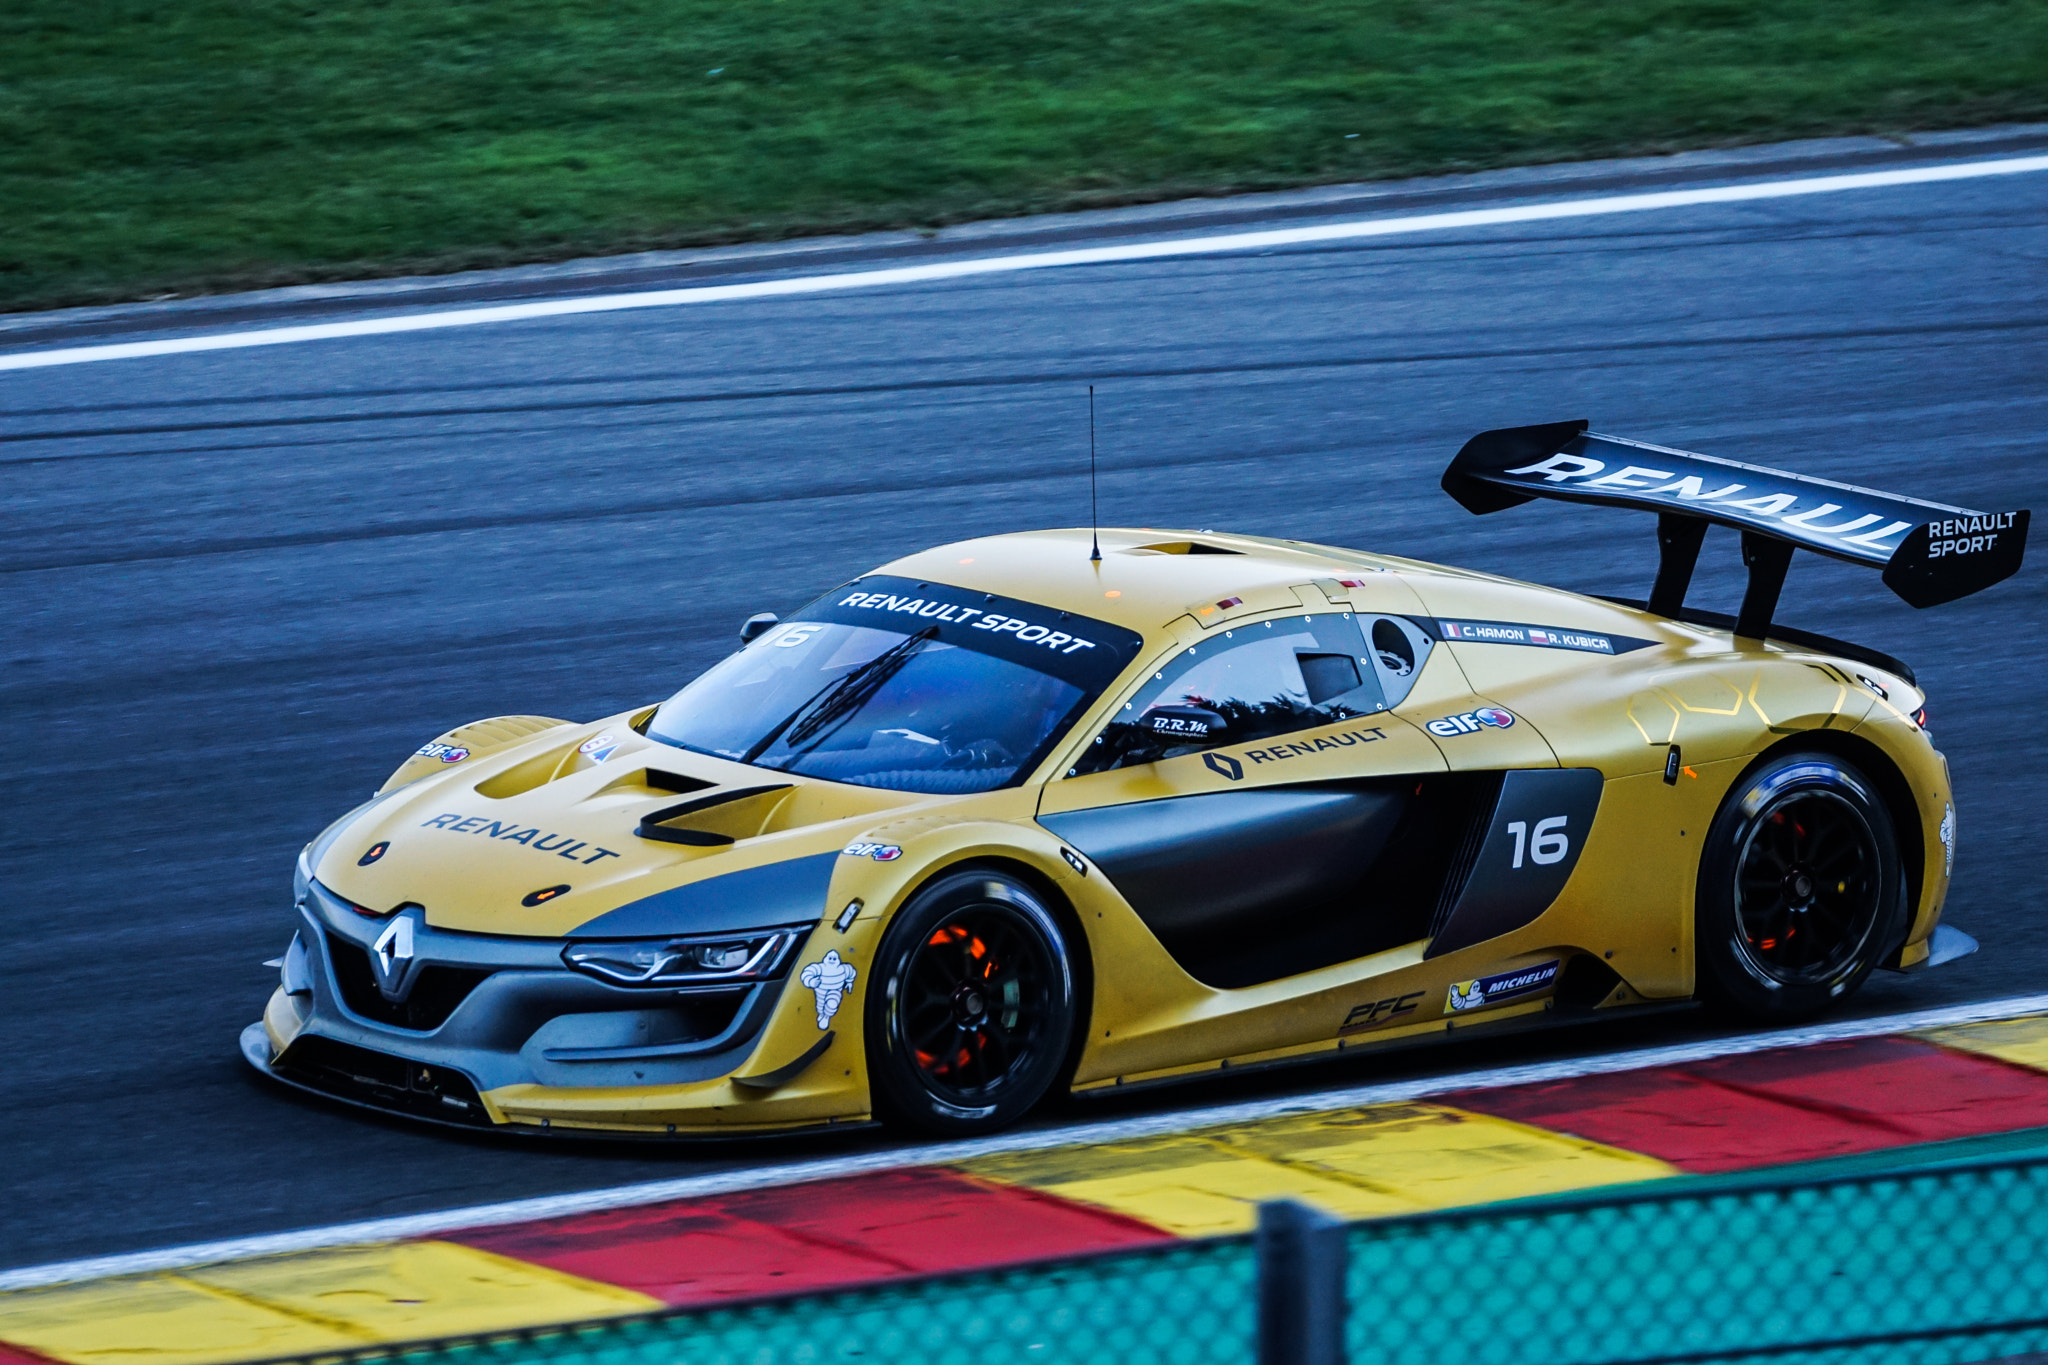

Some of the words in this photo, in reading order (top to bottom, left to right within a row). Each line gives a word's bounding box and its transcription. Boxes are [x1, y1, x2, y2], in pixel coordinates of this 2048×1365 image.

[1504, 453, 1912, 550] RENAUL
[1928, 511, 2018, 539] RENAULT
[1928, 534, 1998, 559] SPORT
[760, 624, 824, 649] 16
[838, 592, 983, 624] RENAULT
[972, 613, 1096, 654] SPORT
[1477, 627, 1525, 641] HAMON
[1548, 633, 1561, 645] R.
[1563, 634, 1610, 649] KUBICA
[1427, 712, 1481, 737] elf
[1244, 726, 1388, 764] RENAULT
[420, 813, 621, 865] RENAULT
[842, 843, 884, 856] elf
[1507, 815, 1569, 869] 16
[1488, 966, 1557, 994] MICHELIN
[1344, 990, 1427, 1025] PFC
